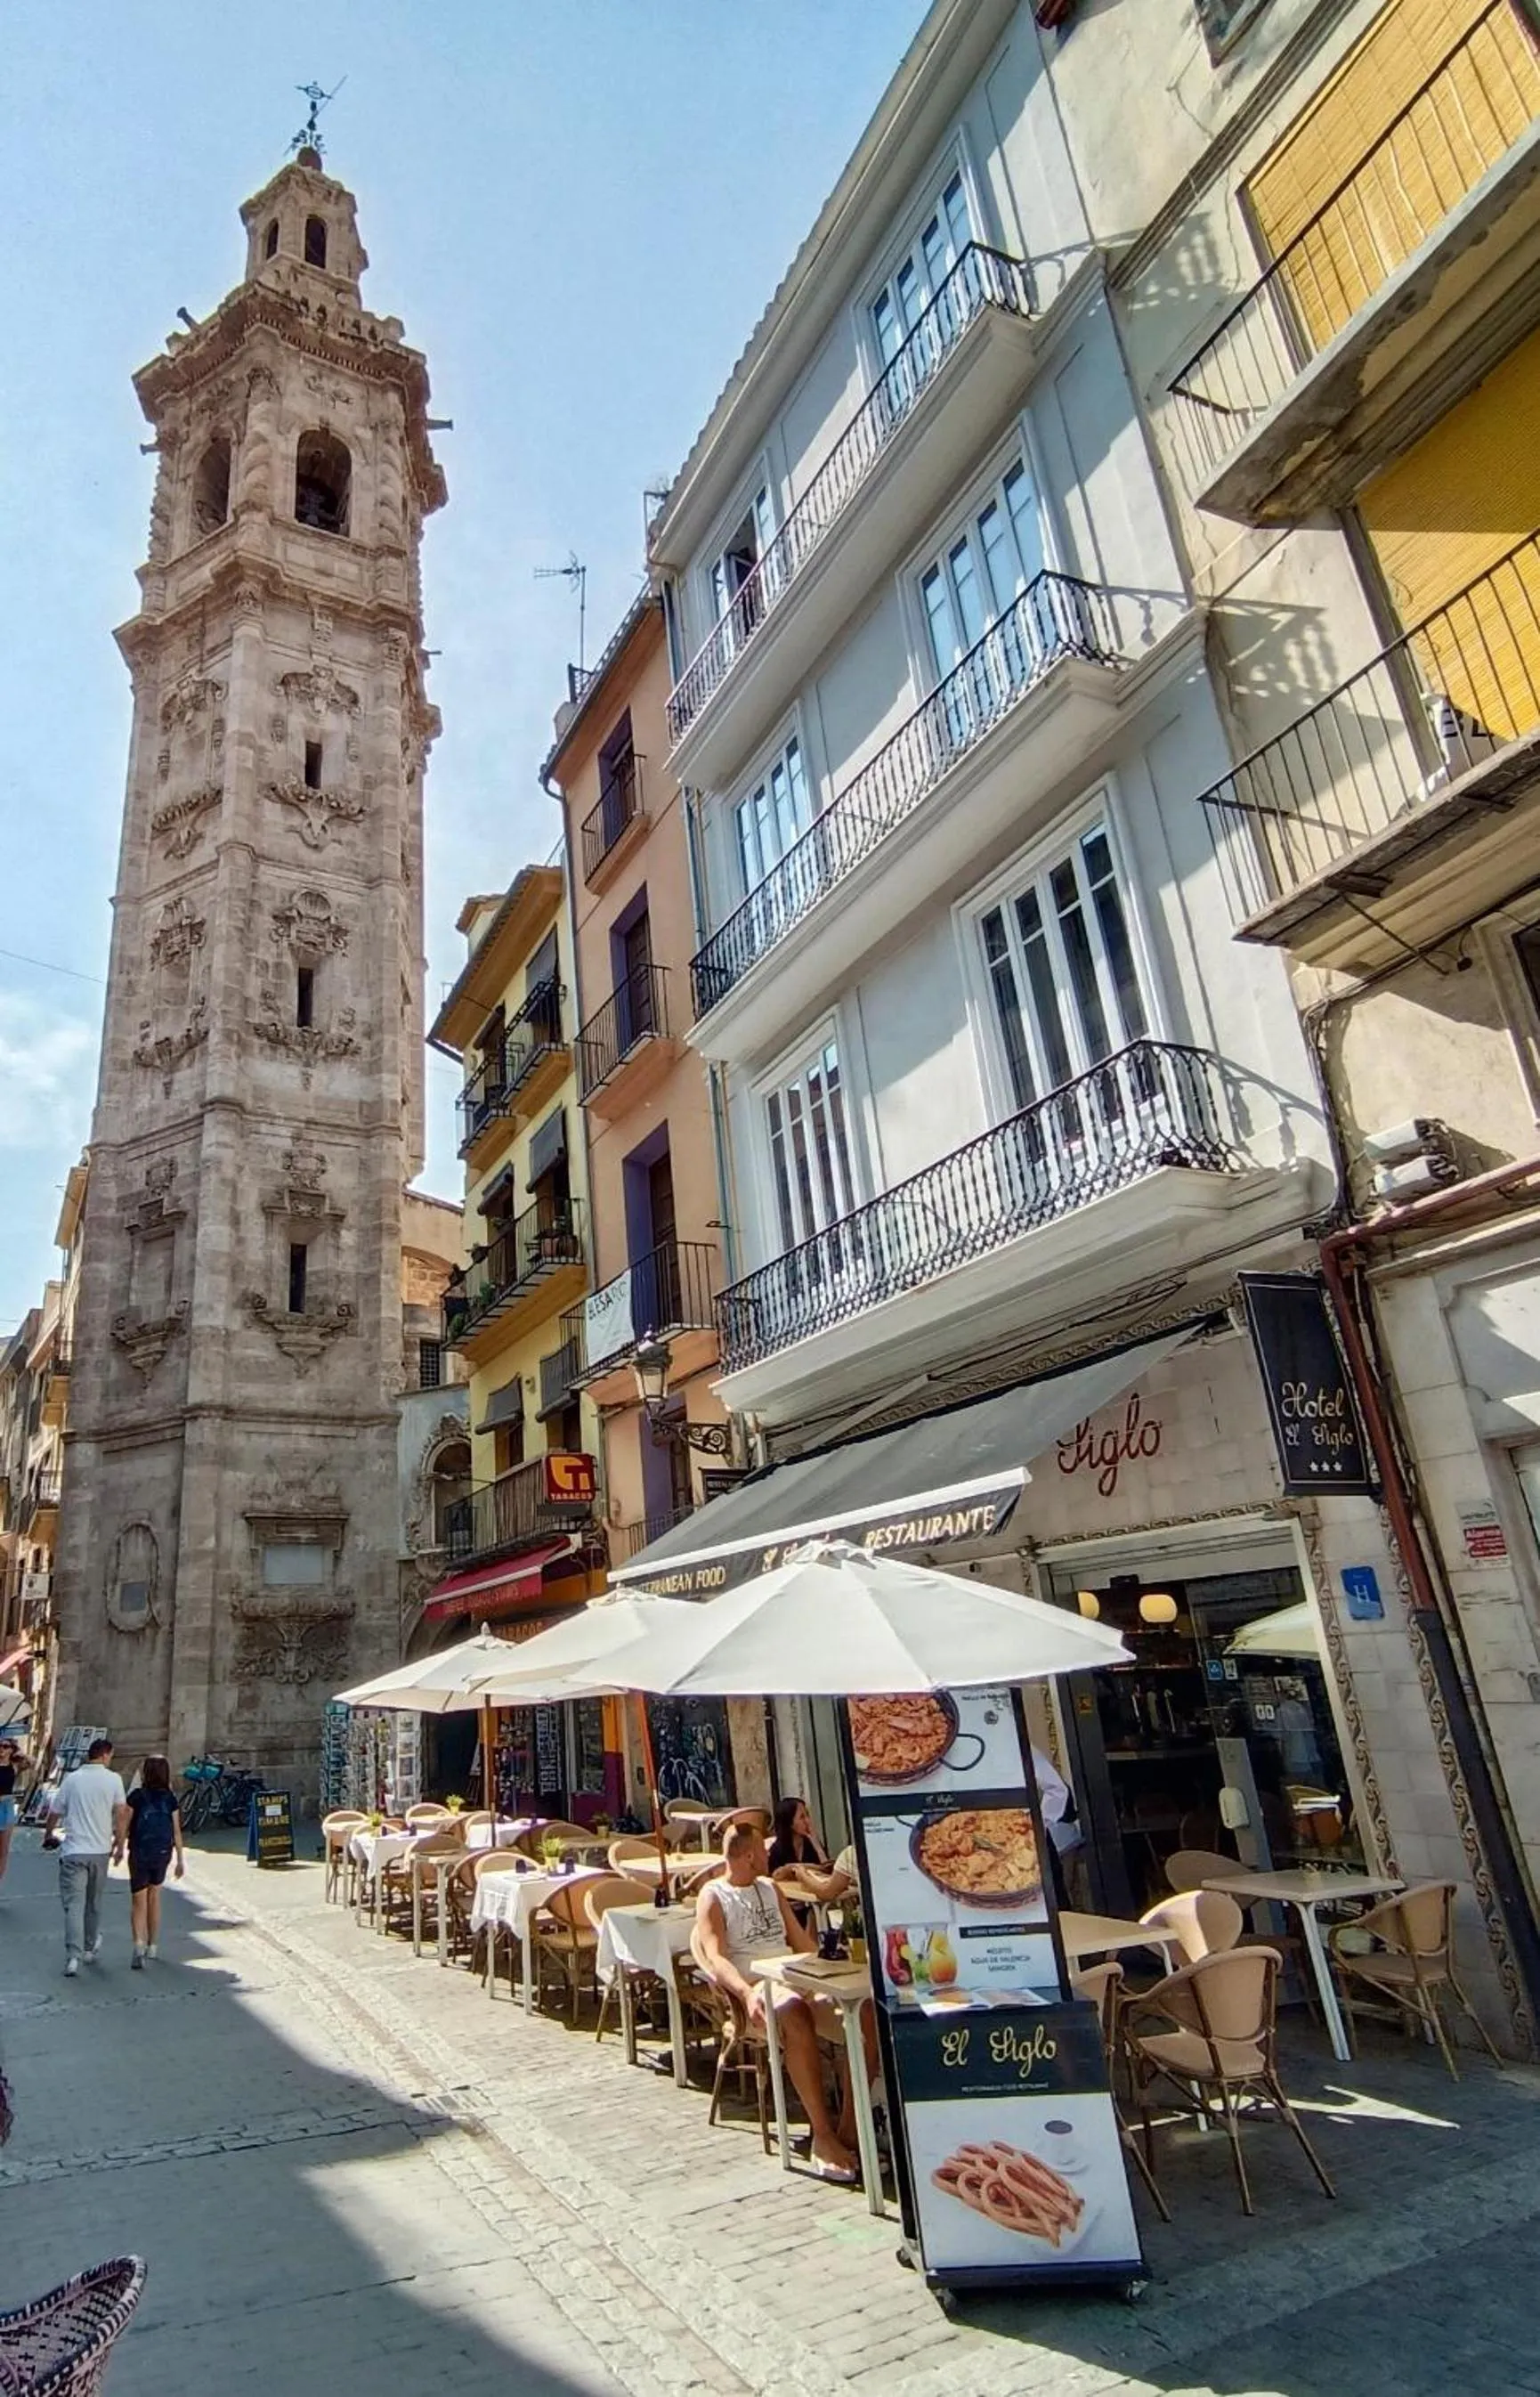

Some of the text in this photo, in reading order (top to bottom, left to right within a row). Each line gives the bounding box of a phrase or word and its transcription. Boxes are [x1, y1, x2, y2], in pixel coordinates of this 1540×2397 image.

[1282, 1382, 1344, 1418] Hotel
[1056, 1393, 1163, 1497] Siglo
[1285, 1423, 1354, 1456] El Siglo
[864, 1505, 995, 1549] RESTAURANTE
[696, 1565, 726, 1589] FOOD
[1353, 1584, 1371, 1604] H
[942, 2024, 1057, 2078] El Siglo
